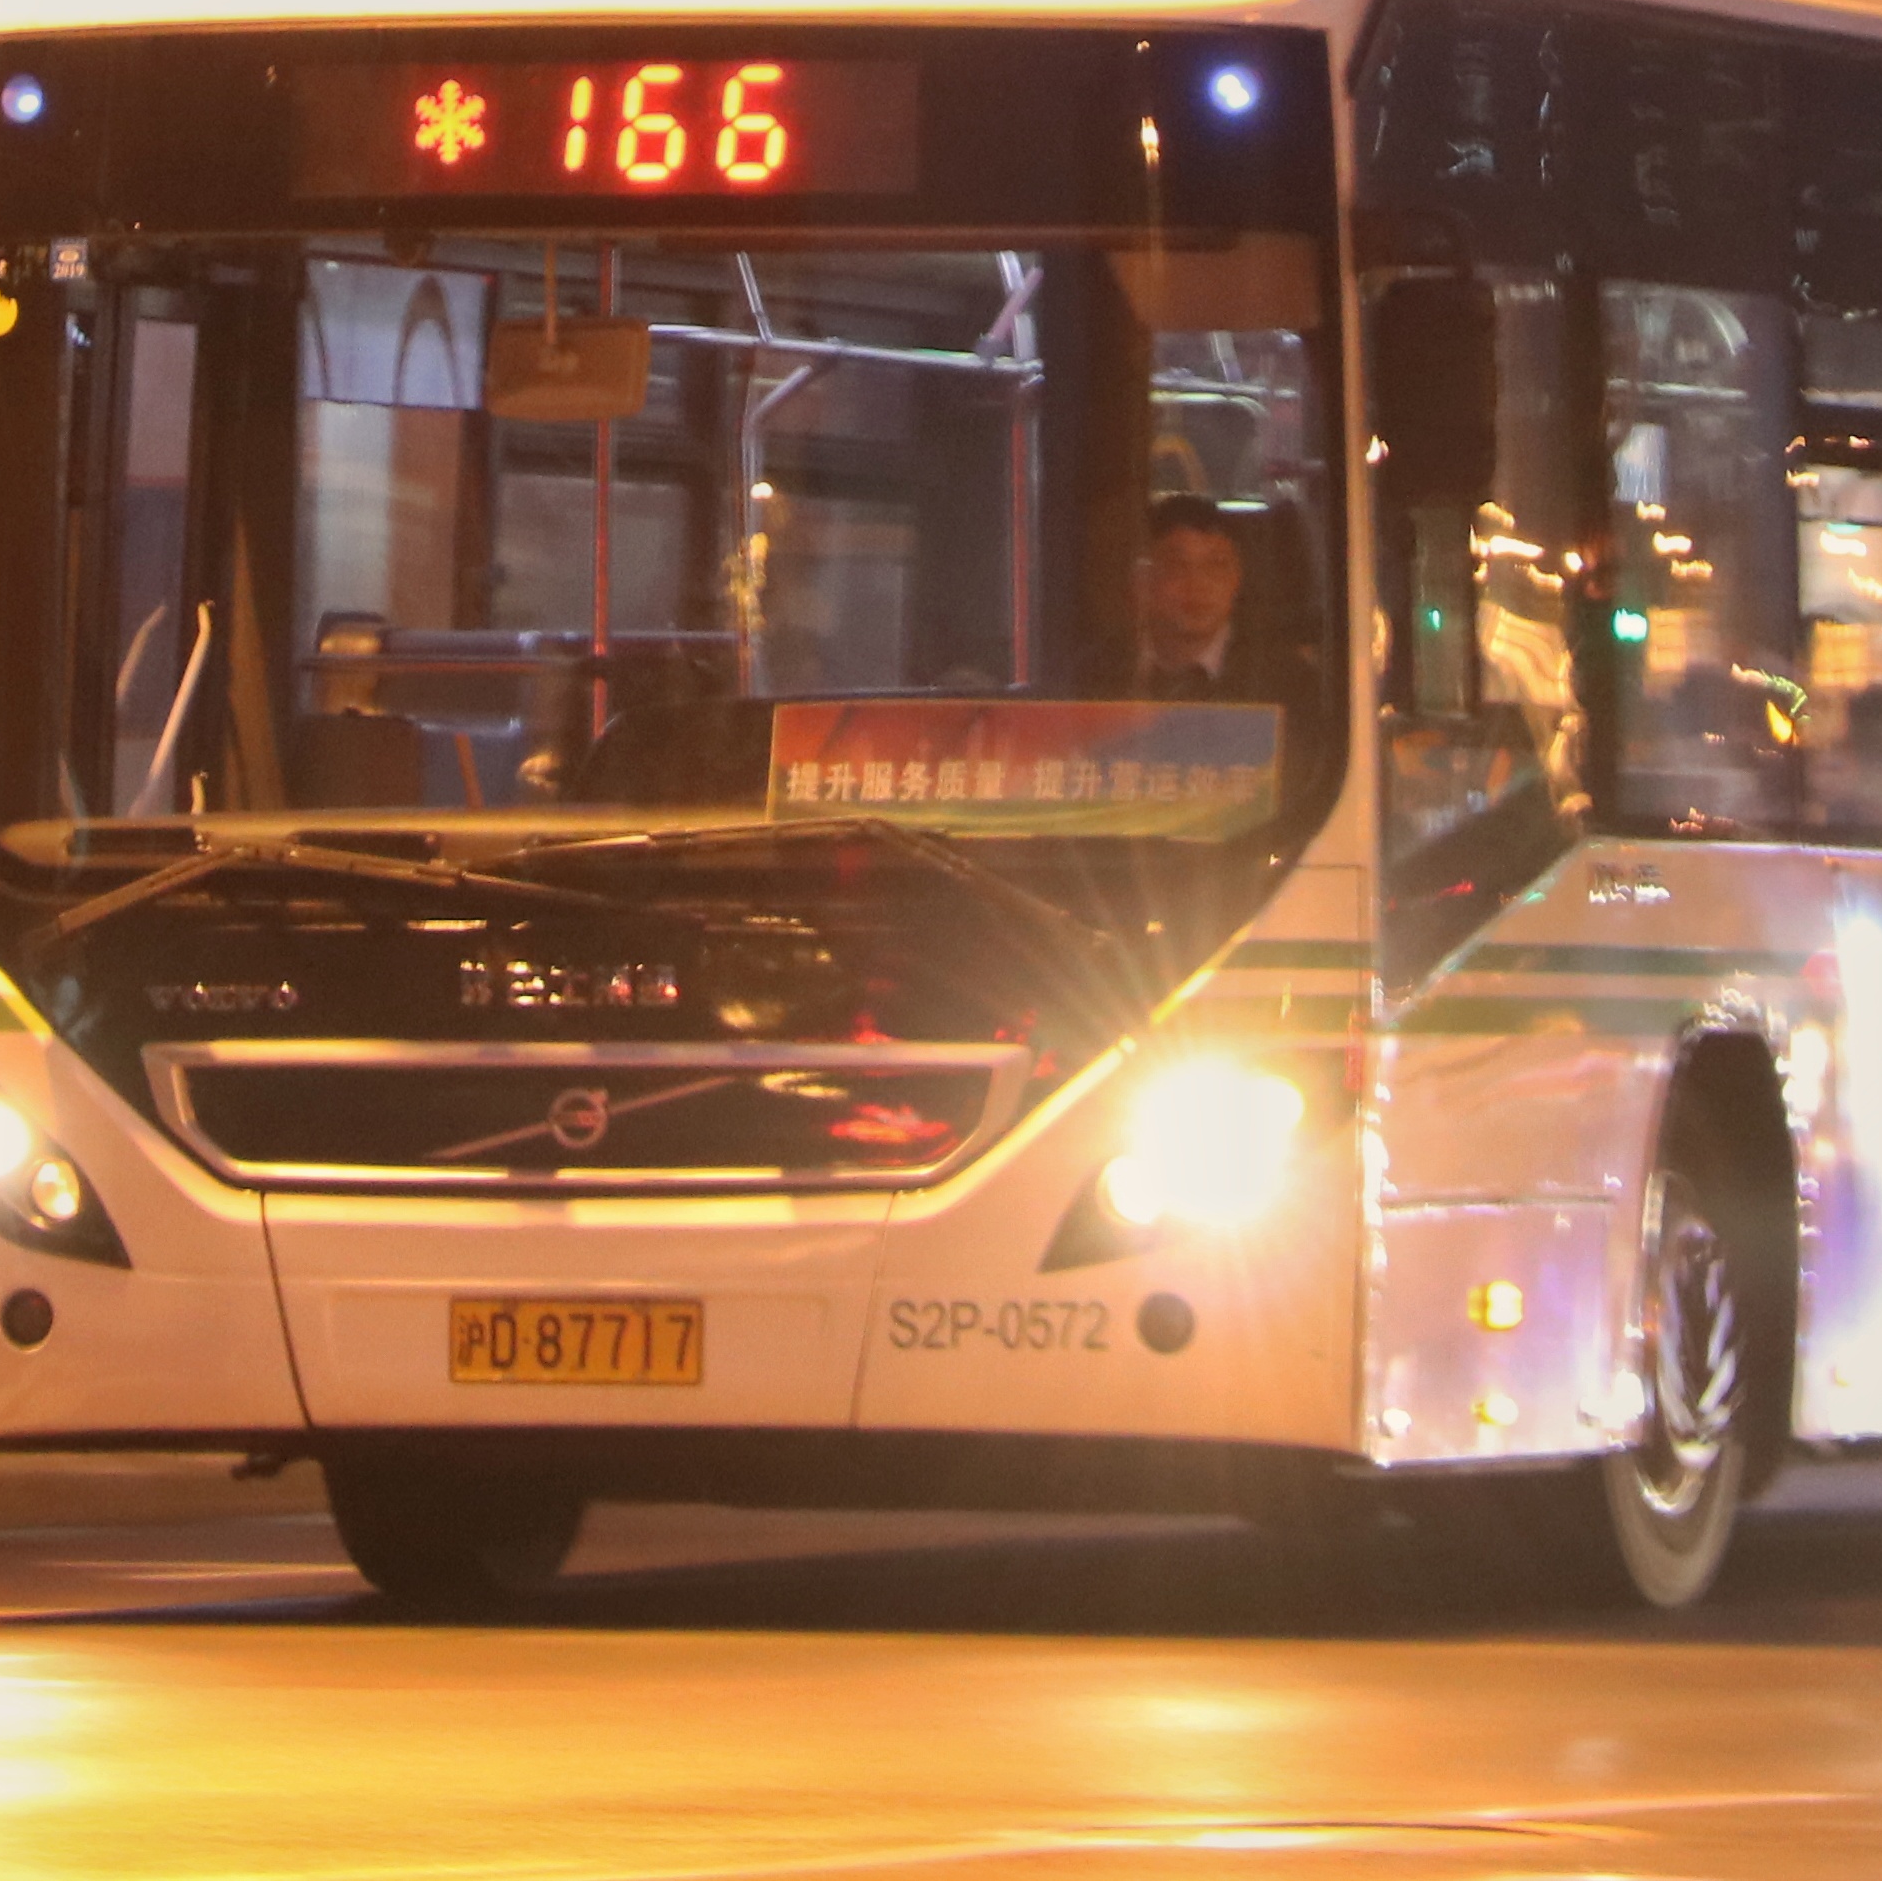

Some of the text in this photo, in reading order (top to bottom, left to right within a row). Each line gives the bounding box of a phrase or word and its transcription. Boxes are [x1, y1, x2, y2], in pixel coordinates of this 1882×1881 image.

[563, 63, 787, 183] 166
[51, 261, 87, 280] 2019
[785, 760, 1006, 803] 提升服务质量
[144, 981, 298, 1012] VOLVO
[888, 1300, 1111, 1352] S2P-0572
